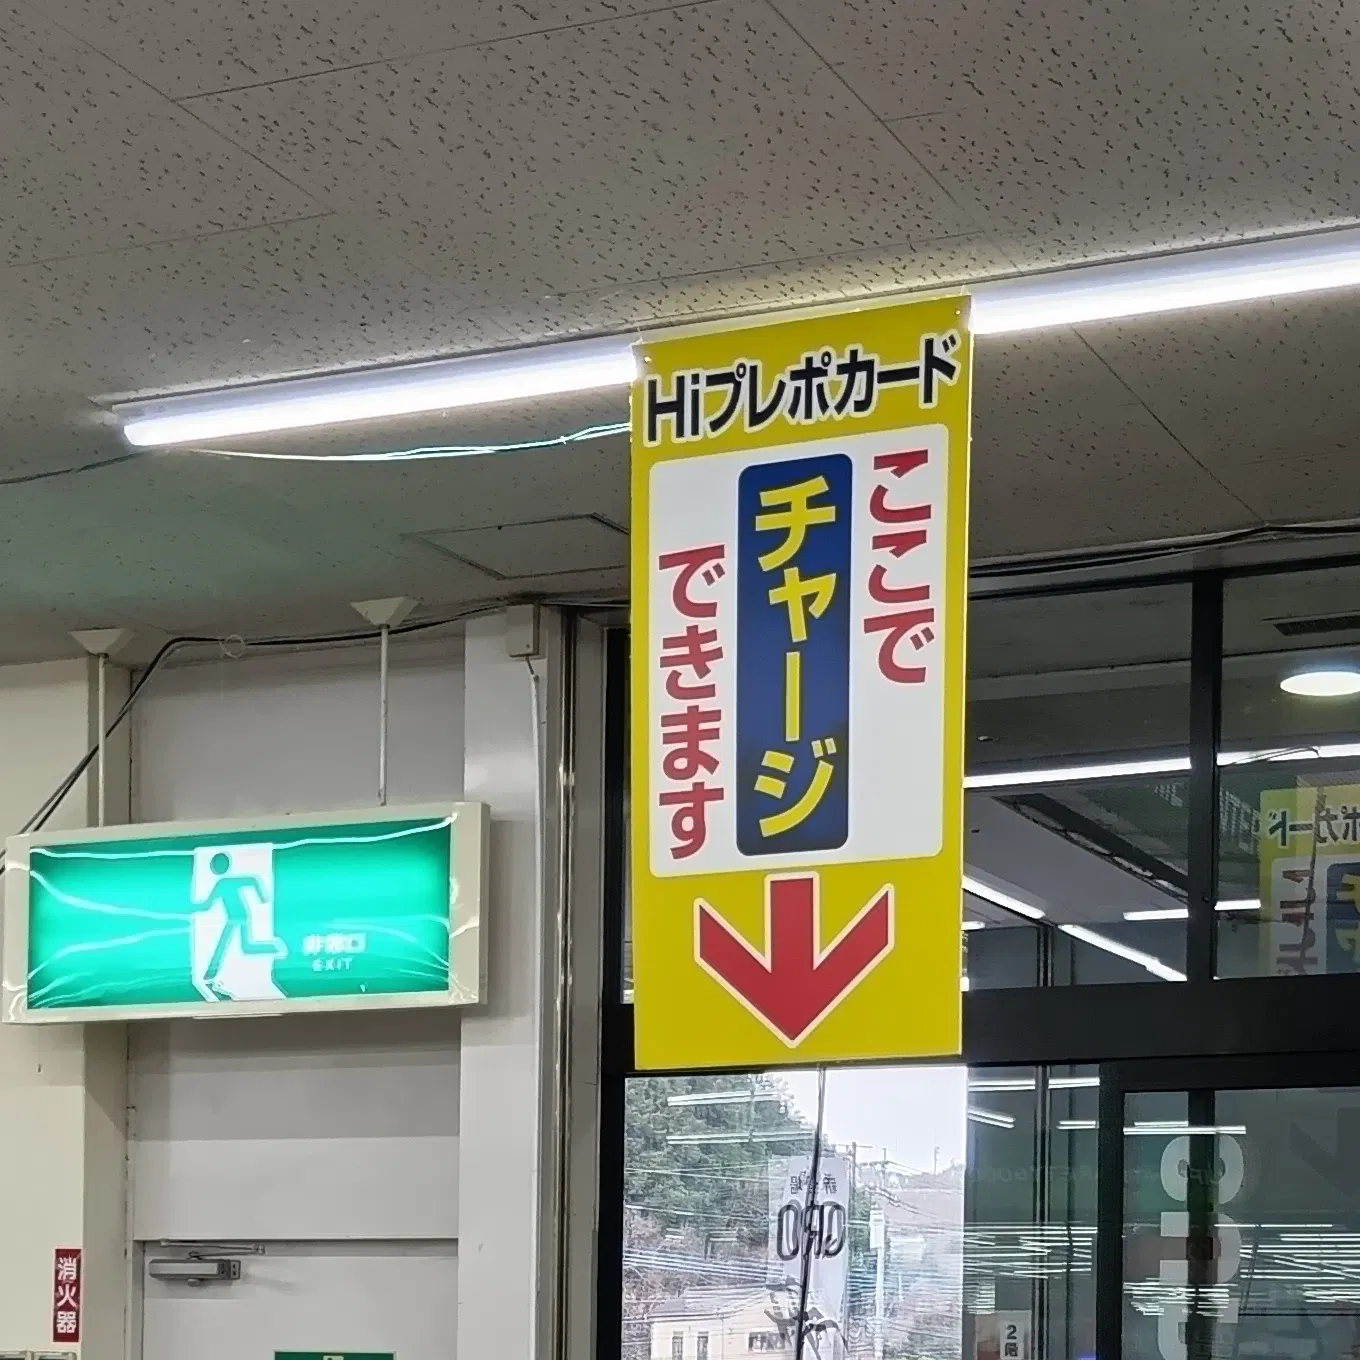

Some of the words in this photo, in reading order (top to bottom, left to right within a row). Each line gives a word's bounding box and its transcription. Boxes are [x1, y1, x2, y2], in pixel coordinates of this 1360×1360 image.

[647, 334, 957, 442] Hiプレポカード
[754, 475, 837, 839] チャージ
[863, 449, 936, 684] ここで
[658, 544, 725, 860] できます
[56, 1256, 78, 1334] 消火器
